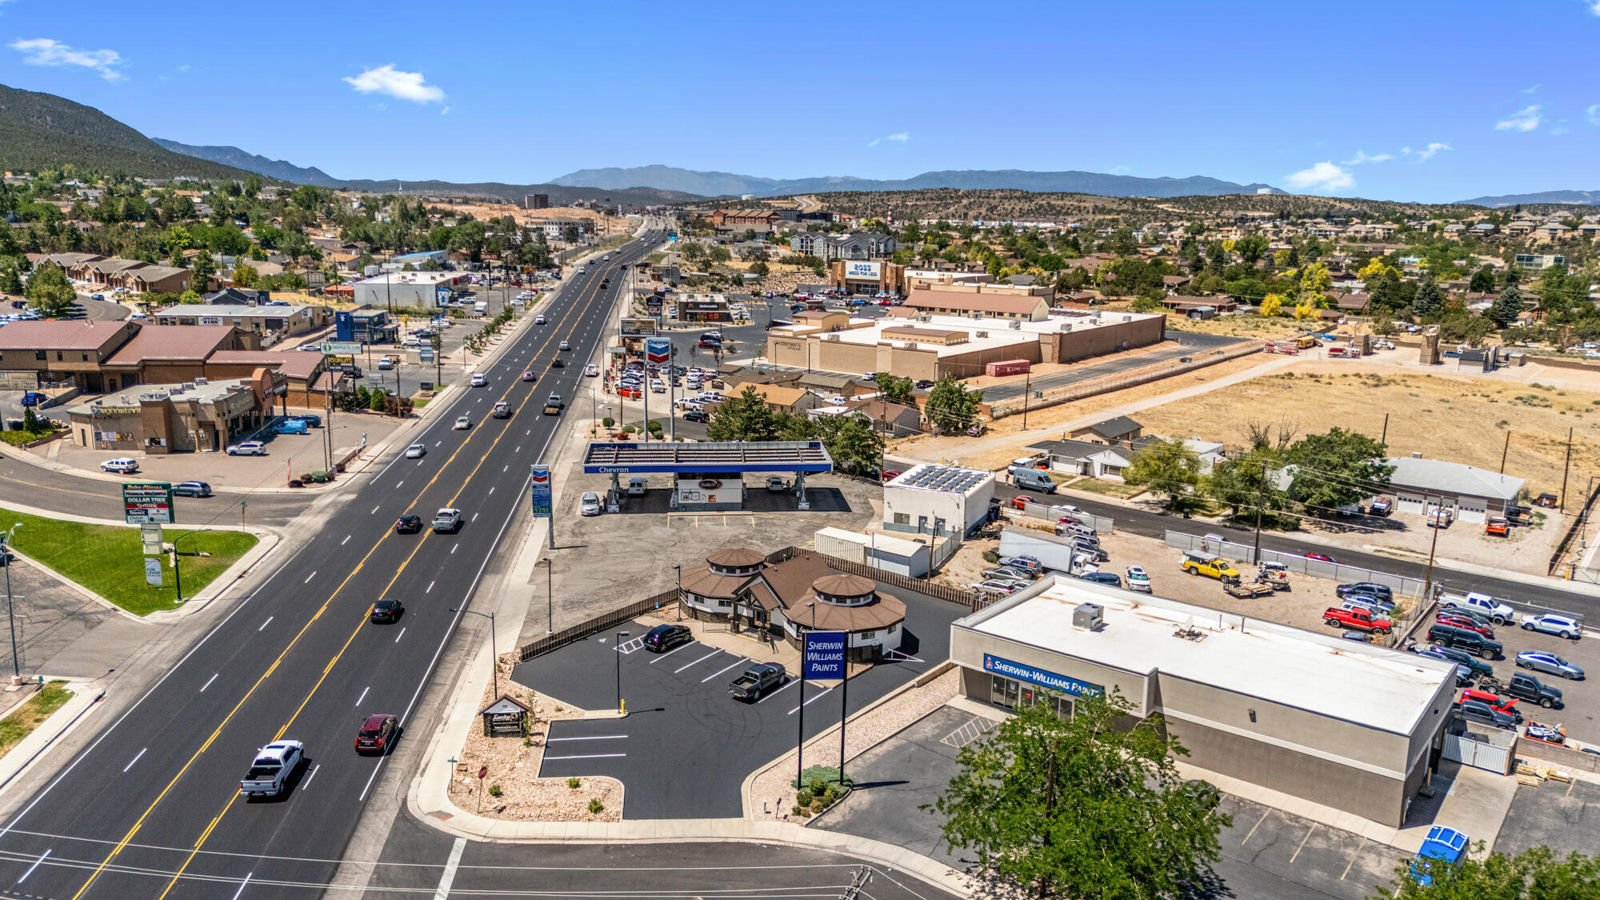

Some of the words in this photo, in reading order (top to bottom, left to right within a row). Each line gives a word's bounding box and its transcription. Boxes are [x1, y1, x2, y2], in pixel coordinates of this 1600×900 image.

[808, 641, 843, 650] SHERWIN
[807, 652, 843, 661] WILLIAMS
[811, 663, 838, 672] PAINTS
[994, 660, 1070, 690] SHERWIN-WILLIAMS
